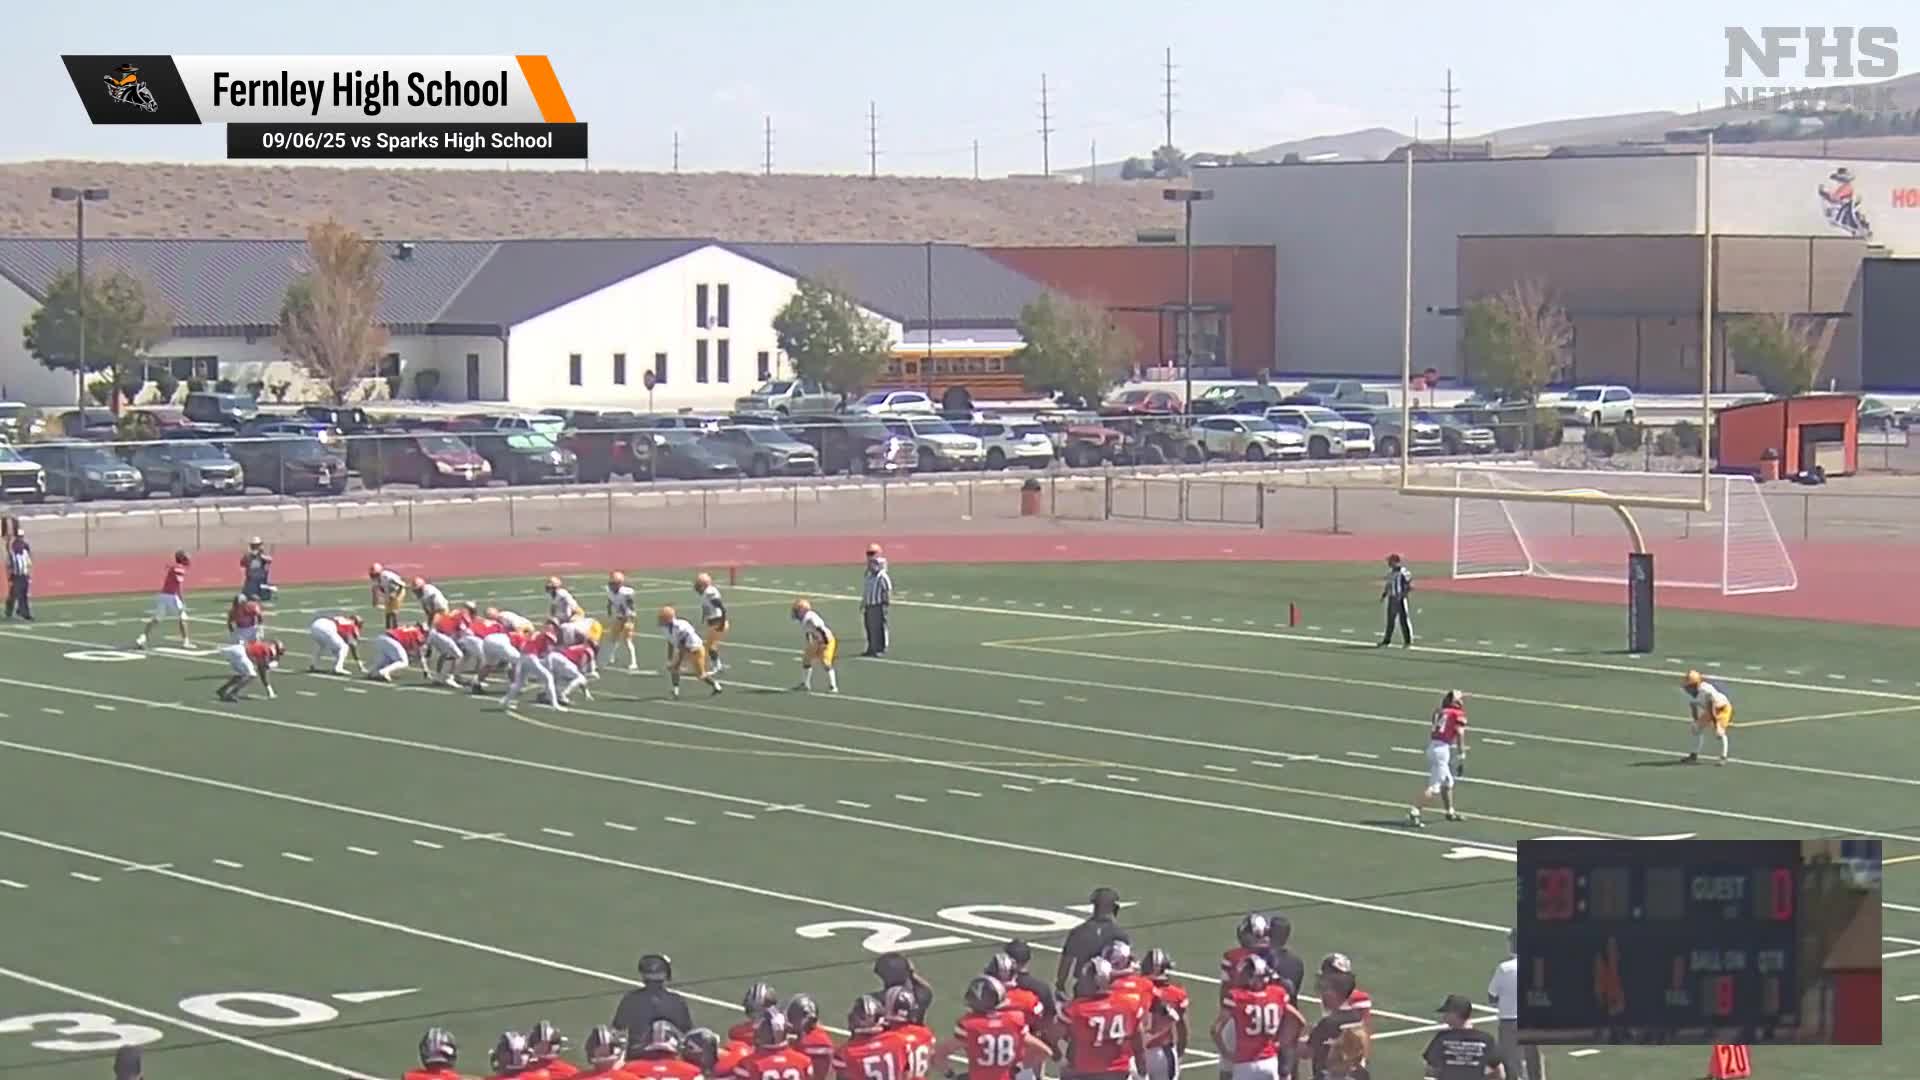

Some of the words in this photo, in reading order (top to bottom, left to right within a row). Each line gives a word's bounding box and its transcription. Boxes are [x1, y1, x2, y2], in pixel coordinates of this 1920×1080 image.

[1691, 874, 1744, 899] GUEST
[796, 903, 1087, 953] 20
[1088, 1013, 1126, 1047] 74
[1245, 1003, 1280, 1035] 30
[862, 1052, 897, 1080] 51
[976, 1033, 1016, 1067] 38
[1720, 1045, 1746, 1074] 20
